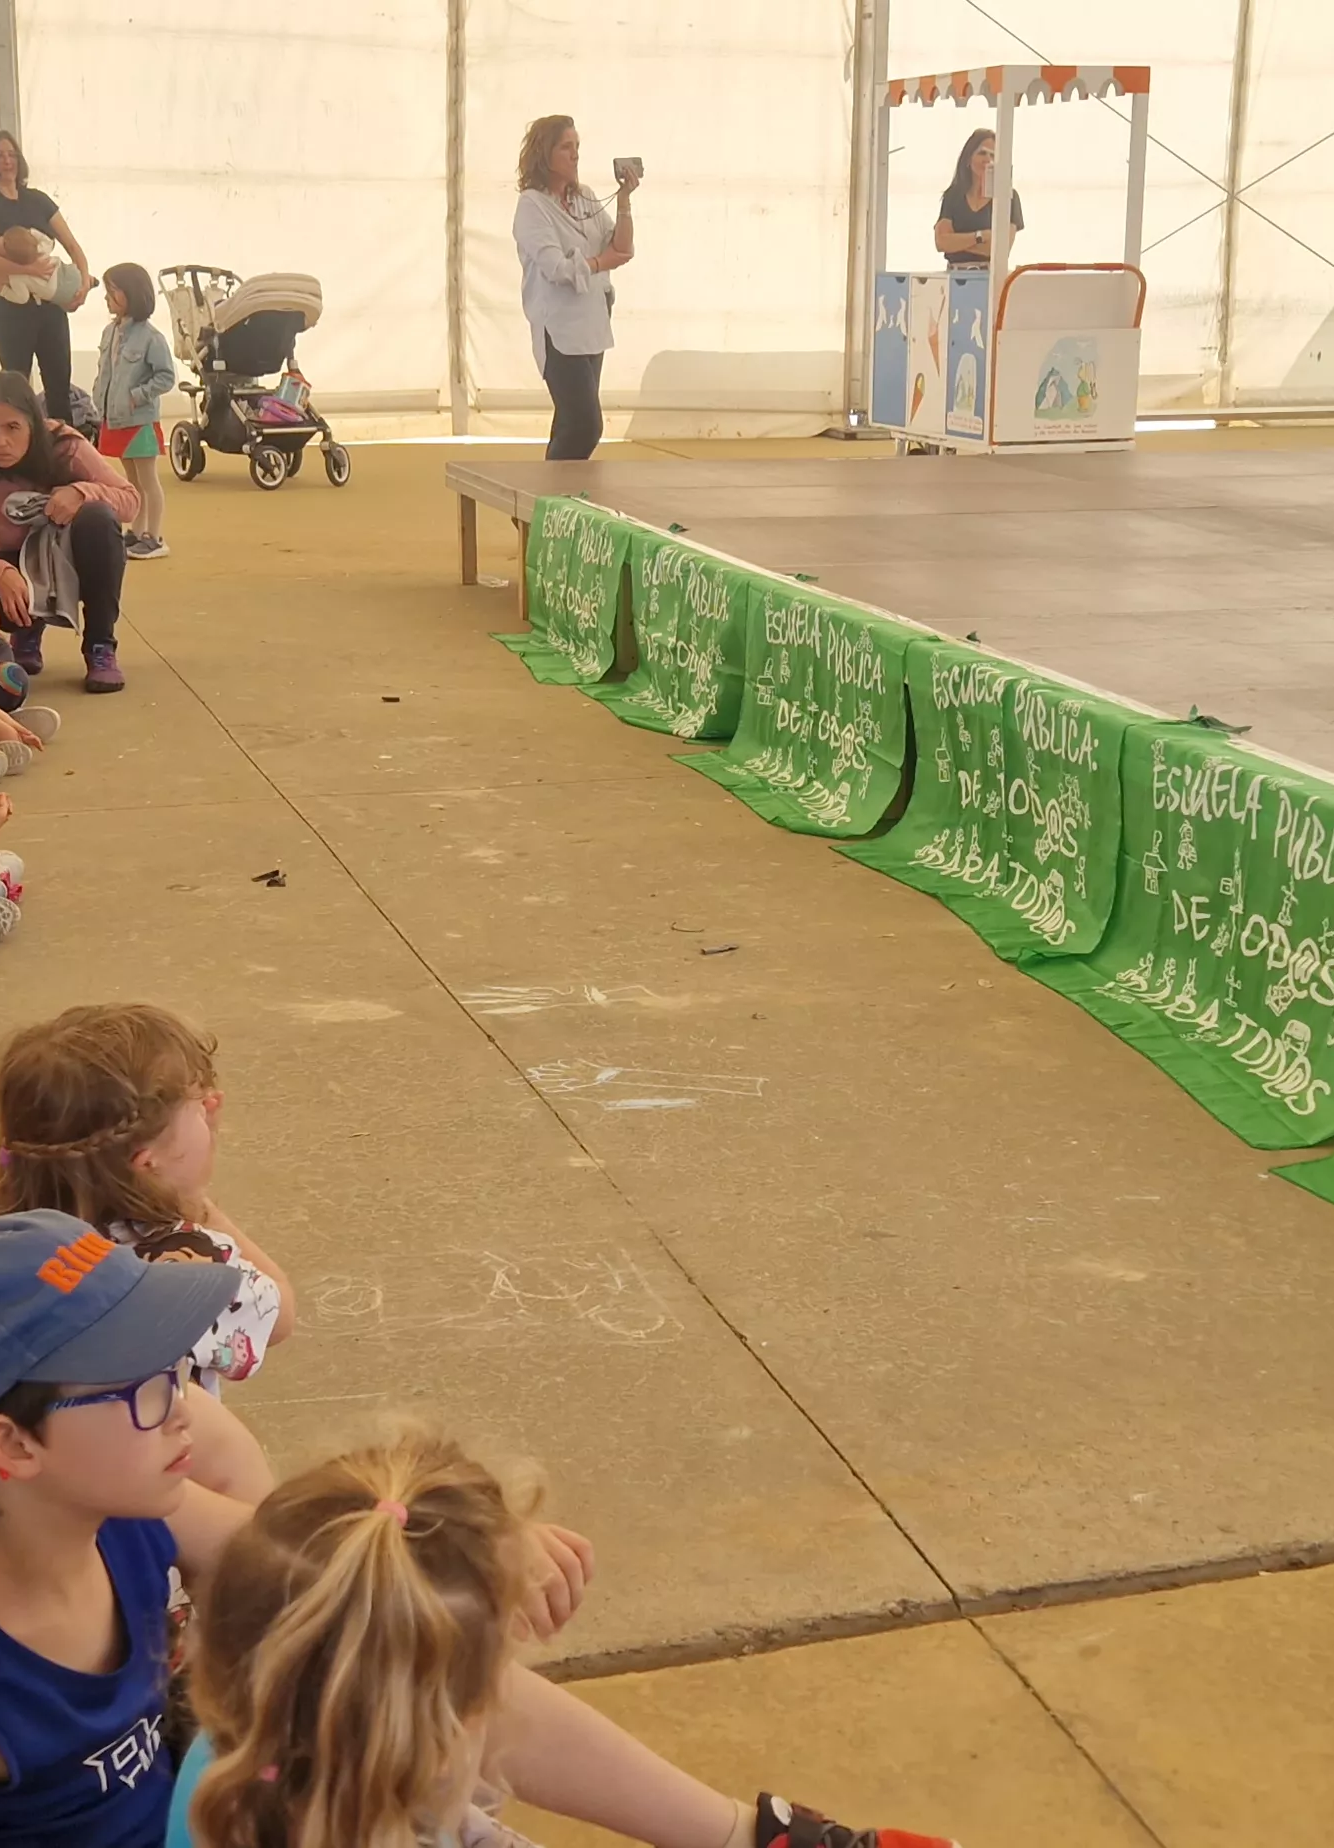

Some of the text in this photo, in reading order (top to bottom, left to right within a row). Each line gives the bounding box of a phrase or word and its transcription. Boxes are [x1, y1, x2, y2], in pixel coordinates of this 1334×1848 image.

[776, 698, 803, 734] DE
[957, 769, 981, 808] DE
[1171, 889, 1212, 942] DE
